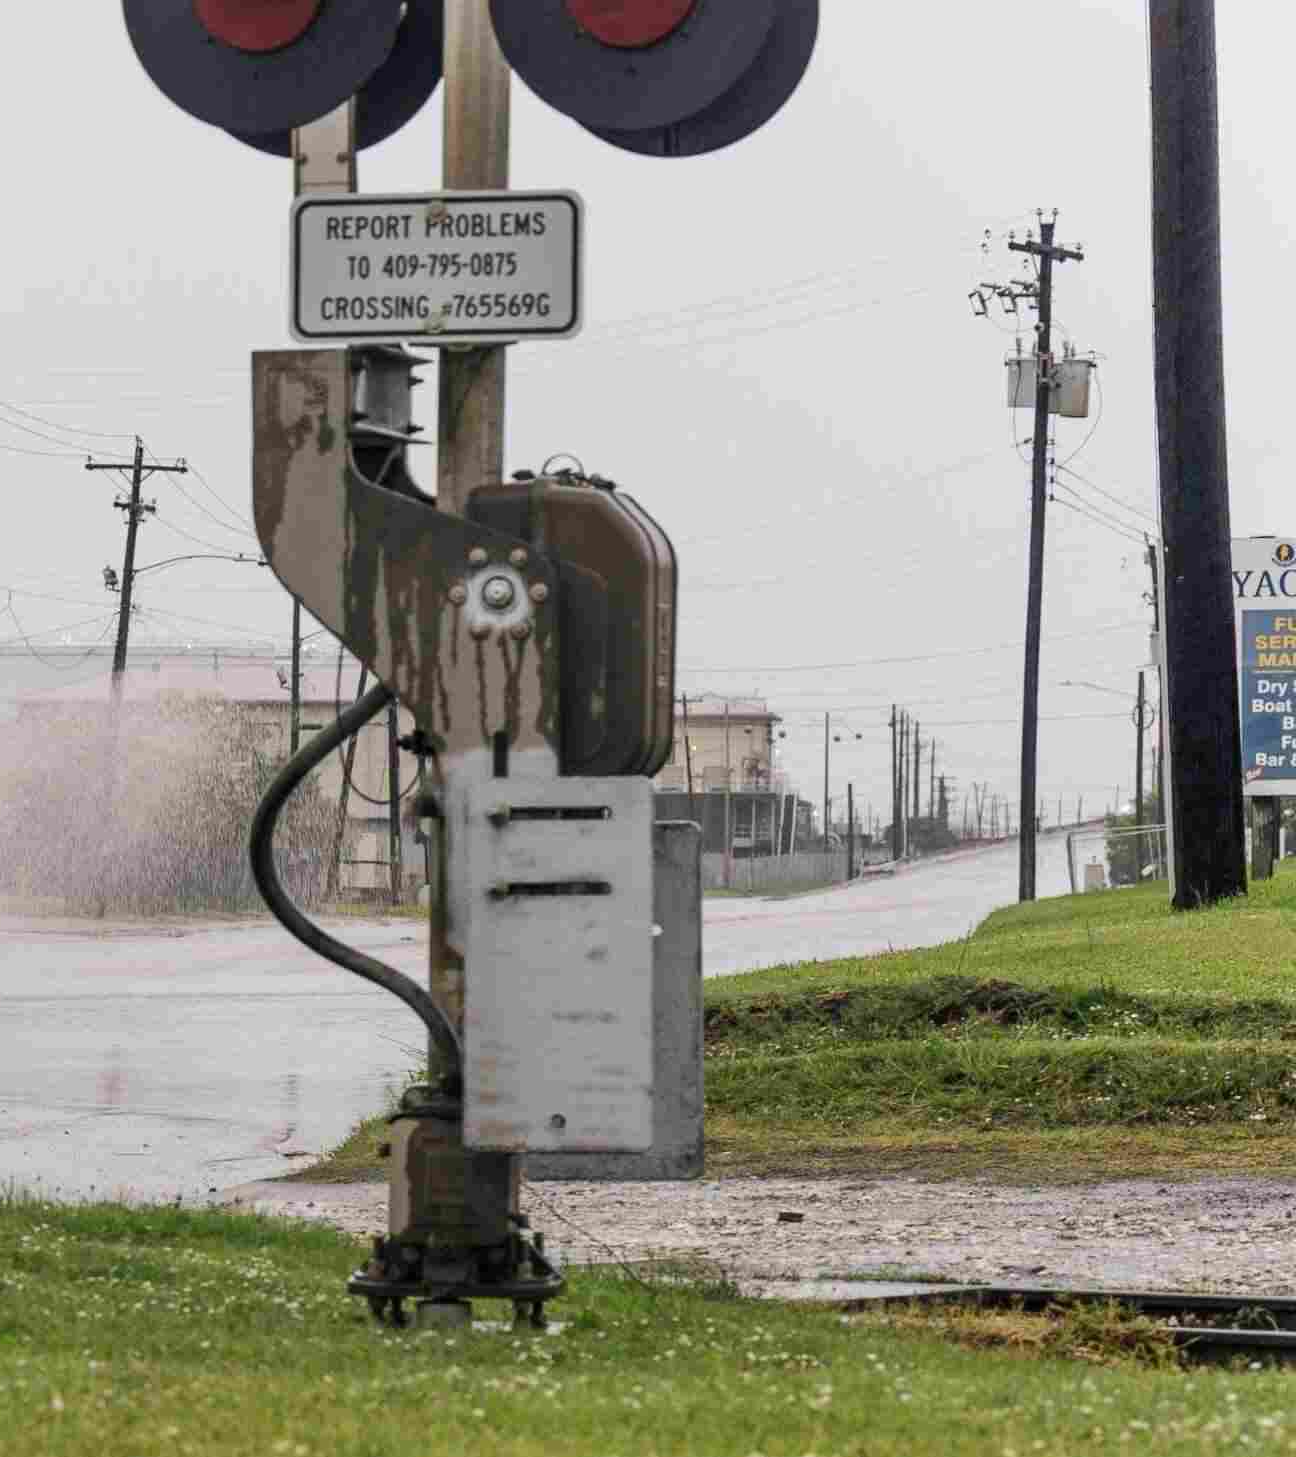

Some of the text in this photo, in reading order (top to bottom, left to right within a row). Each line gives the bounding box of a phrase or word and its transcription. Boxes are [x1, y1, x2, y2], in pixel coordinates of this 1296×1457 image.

[326, 211, 546, 240] REPORT PROBLEMS
[347, 251, 517, 279] TO 409-795-0875
[320, 296, 430, 321] CROSSING
[1257, 679, 1288, 697] Dry
[1252, 699, 1292, 713] Boat
[1256, 752, 1285, 767] Bar
